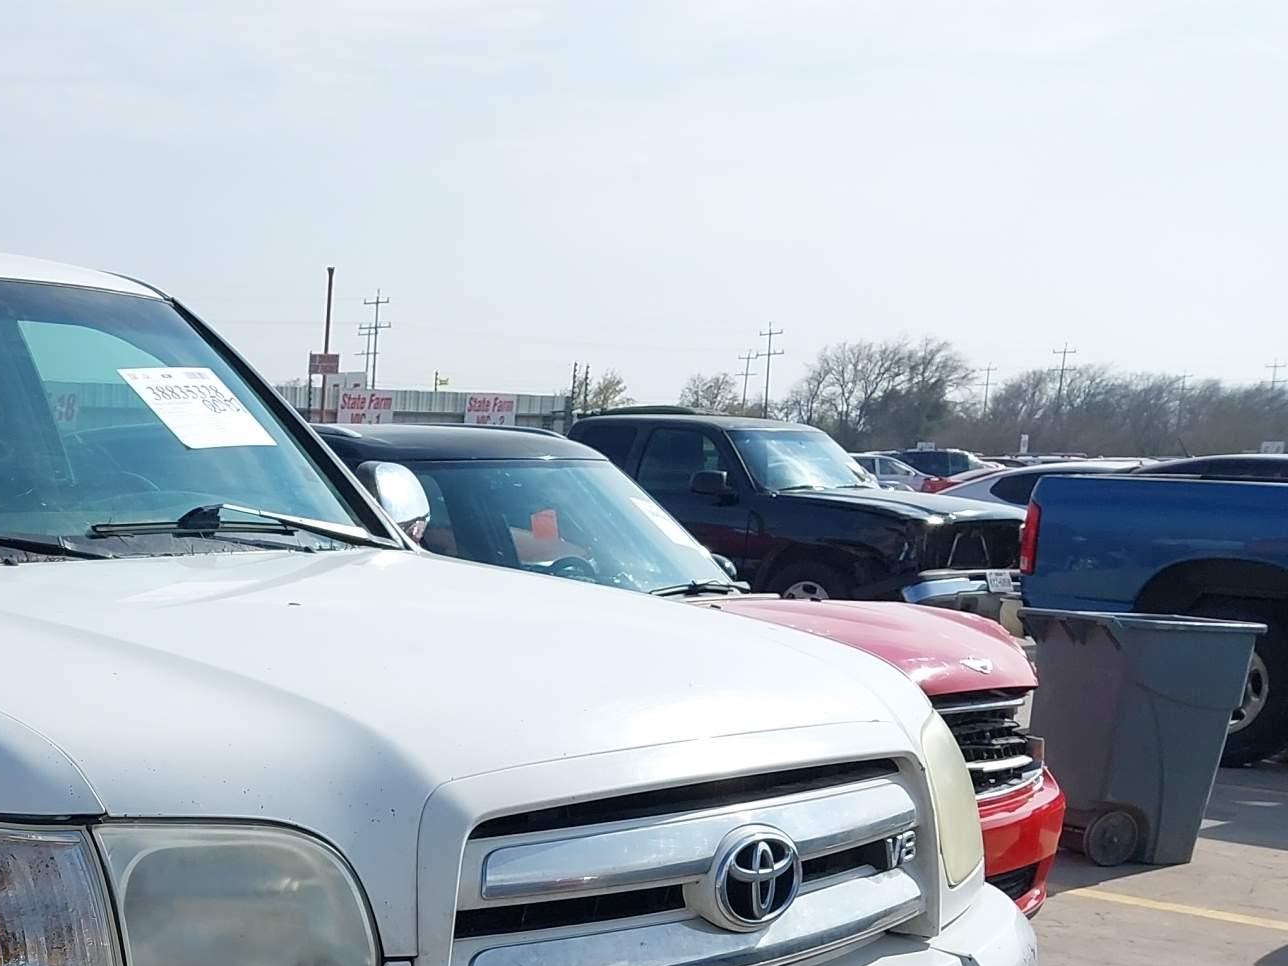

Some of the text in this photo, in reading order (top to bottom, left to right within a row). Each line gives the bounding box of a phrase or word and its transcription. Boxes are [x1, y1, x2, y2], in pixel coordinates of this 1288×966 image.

[146, 385, 225, 400] 38835328
[340, 393, 393, 410] State Farm
[467, 397, 514, 412] State Farm
[885, 831, 917, 868] V8
